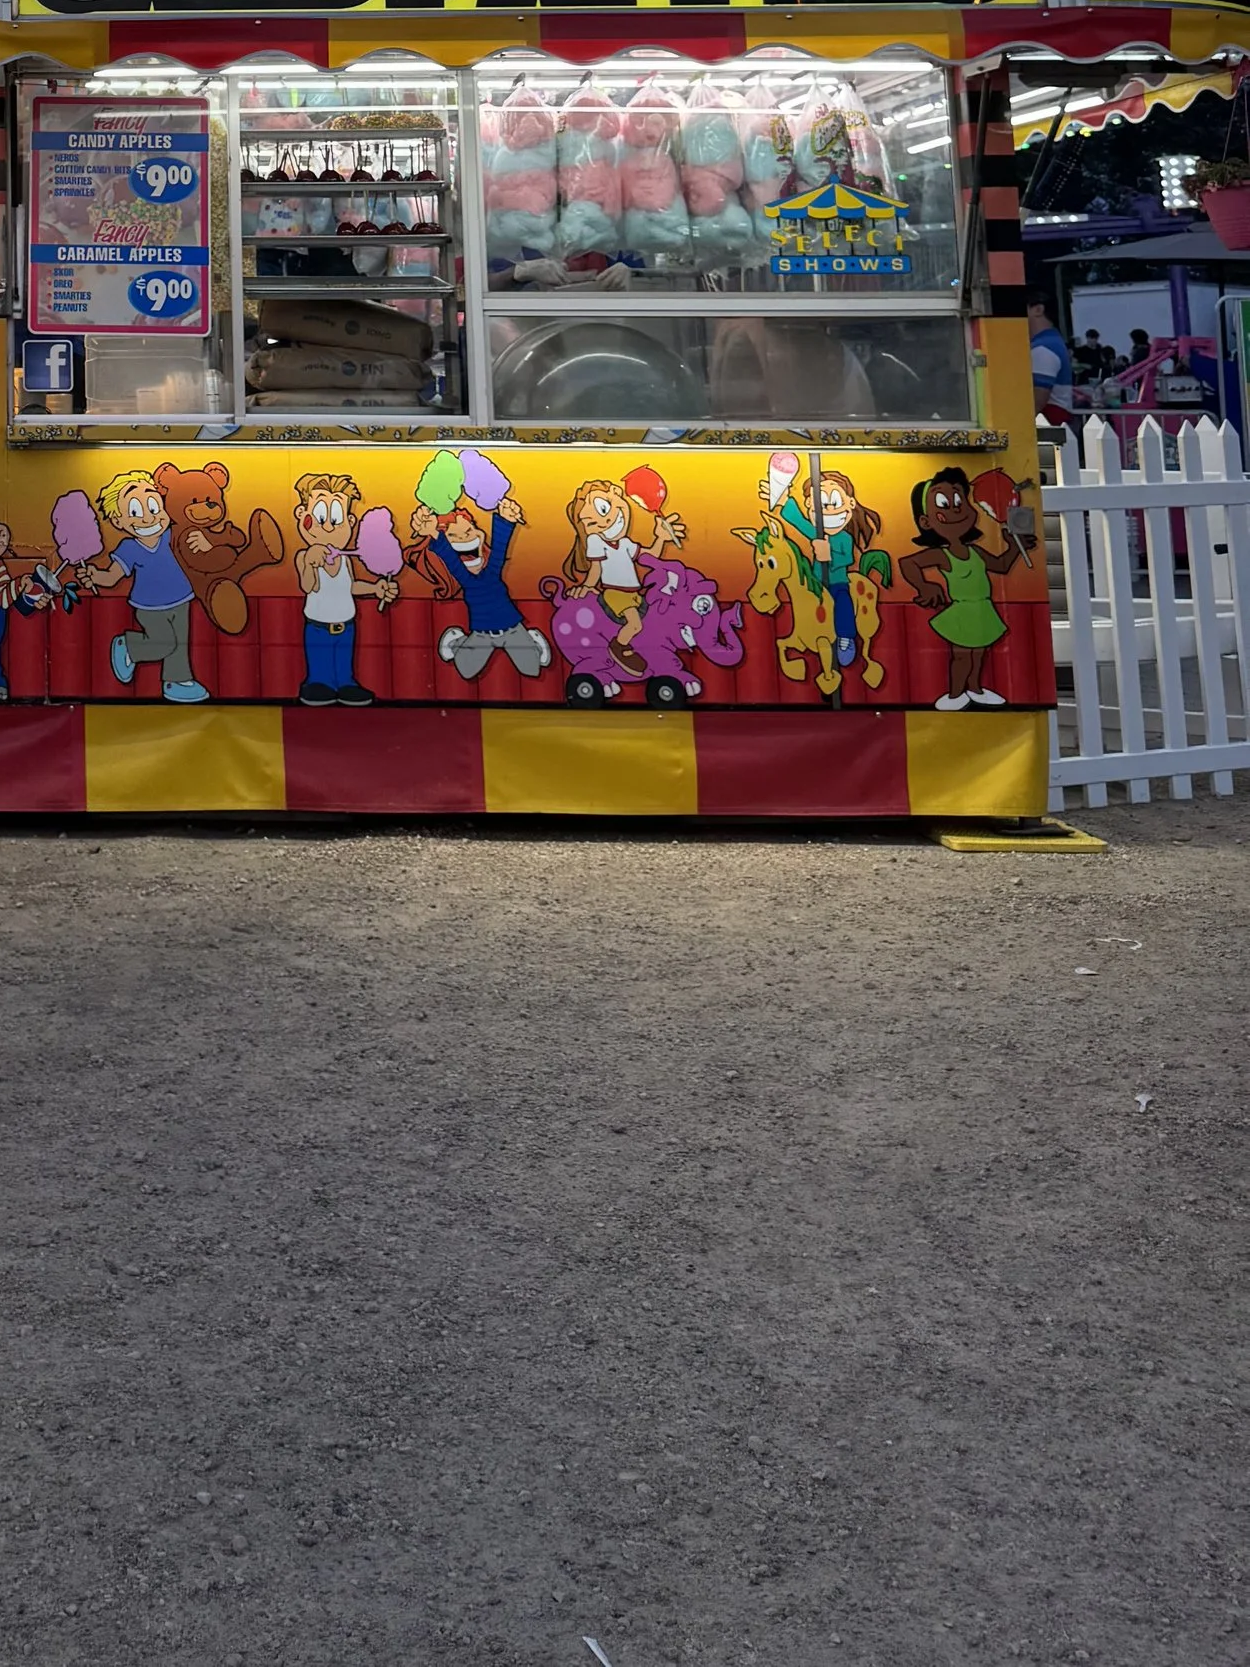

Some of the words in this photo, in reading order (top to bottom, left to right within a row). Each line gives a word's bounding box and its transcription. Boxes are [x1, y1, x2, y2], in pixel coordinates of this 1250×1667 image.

[68, 134, 116, 148] CANDY
[119, 134, 173, 149] APPLES
[54, 165, 85, 174] COTTON
[86, 165, 112, 174] CANDY
[114, 165, 132, 174] BITS
[54, 176, 93, 186] SMARTIES
[53, 188, 95, 197] SPRINKLES
[93, 219, 150, 248] Fancy
[57, 246, 124, 262] CARAMEL
[128, 247, 183, 263] APPLES
[53, 291, 92, 300] SMARTIES
[53, 303, 88, 312] PEANUTS
